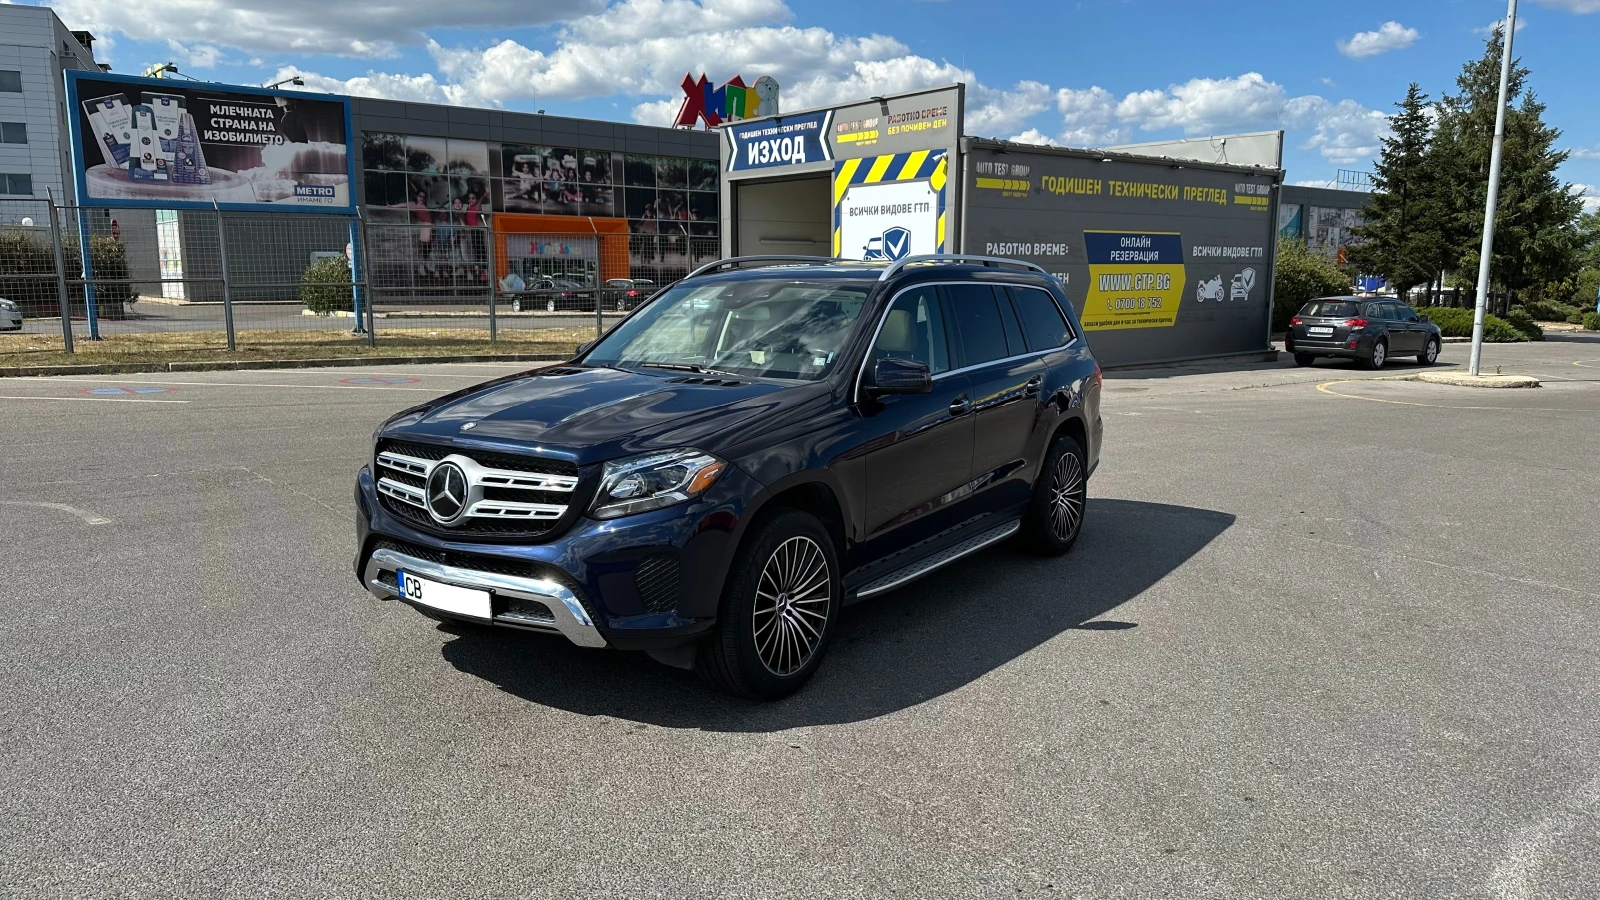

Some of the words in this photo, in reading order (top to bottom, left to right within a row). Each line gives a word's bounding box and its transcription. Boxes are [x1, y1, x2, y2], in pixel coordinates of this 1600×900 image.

[209, 104, 275, 119] МЛЕЧНАТА
[887, 110, 920, 125] РАБОТНО
[921, 106, 948, 119] ВРЕМЕ
[210, 117, 258, 131] СТРАНА
[258, 121, 276, 132] НА
[739, 129, 762, 140] ГОДИШЕН
[762, 125, 794, 136] ТЕХНИЧЕСКИ
[794, 121, 818, 132] ПРЕГЛЕД
[887, 126, 900, 136] БЕЗ
[901, 121, 932, 133] ПОЧИВЕН
[933, 118, 947, 129] ДЕН
[203, 129, 284, 145] ИЗОБИЛИЕТО
[748, 135, 806, 166] ИЗХОД
[975, 161, 993, 174] AUTO
[994, 162, 1009, 176] TEST
[296, 186, 333, 196] METRO
[1041, 175, 1102, 196] ГОДИШЕН
[1108, 180, 1179, 200] ТЕХНИЧЕСКИ
[1183, 186, 1227, 206] ПРЕГЛЕД
[1234, 183, 1246, 194] AUTO
[1246, 183, 1256, 194] TEST
[1256, 184, 1270, 195] GROUP
[849, 205, 879, 217] ВСИЧКИ
[880, 203, 912, 216] ВИДОВЕ
[913, 202, 930, 213] ГТП
[986, 242, 1032, 256] РАБОТНО
[1033, 243, 1069, 256] ВРЕМЕ:
[1120, 235, 1151, 248] ОНЛАЙН
[1110, 250, 1159, 263] РЕЗЕРВАЦИЯ
[1192, 245, 1222, 257] ВСИЧКИ
[1222, 246, 1250, 259] ВИДОВЕ
[1250, 247, 1263, 258] ГТП
[1098, 273, 1171, 292] WWW.GTP.BG
[1115, 297, 1135, 310] 0700
[1137, 297, 1145, 309] 18
[1147, 296, 1162, 309] 752
